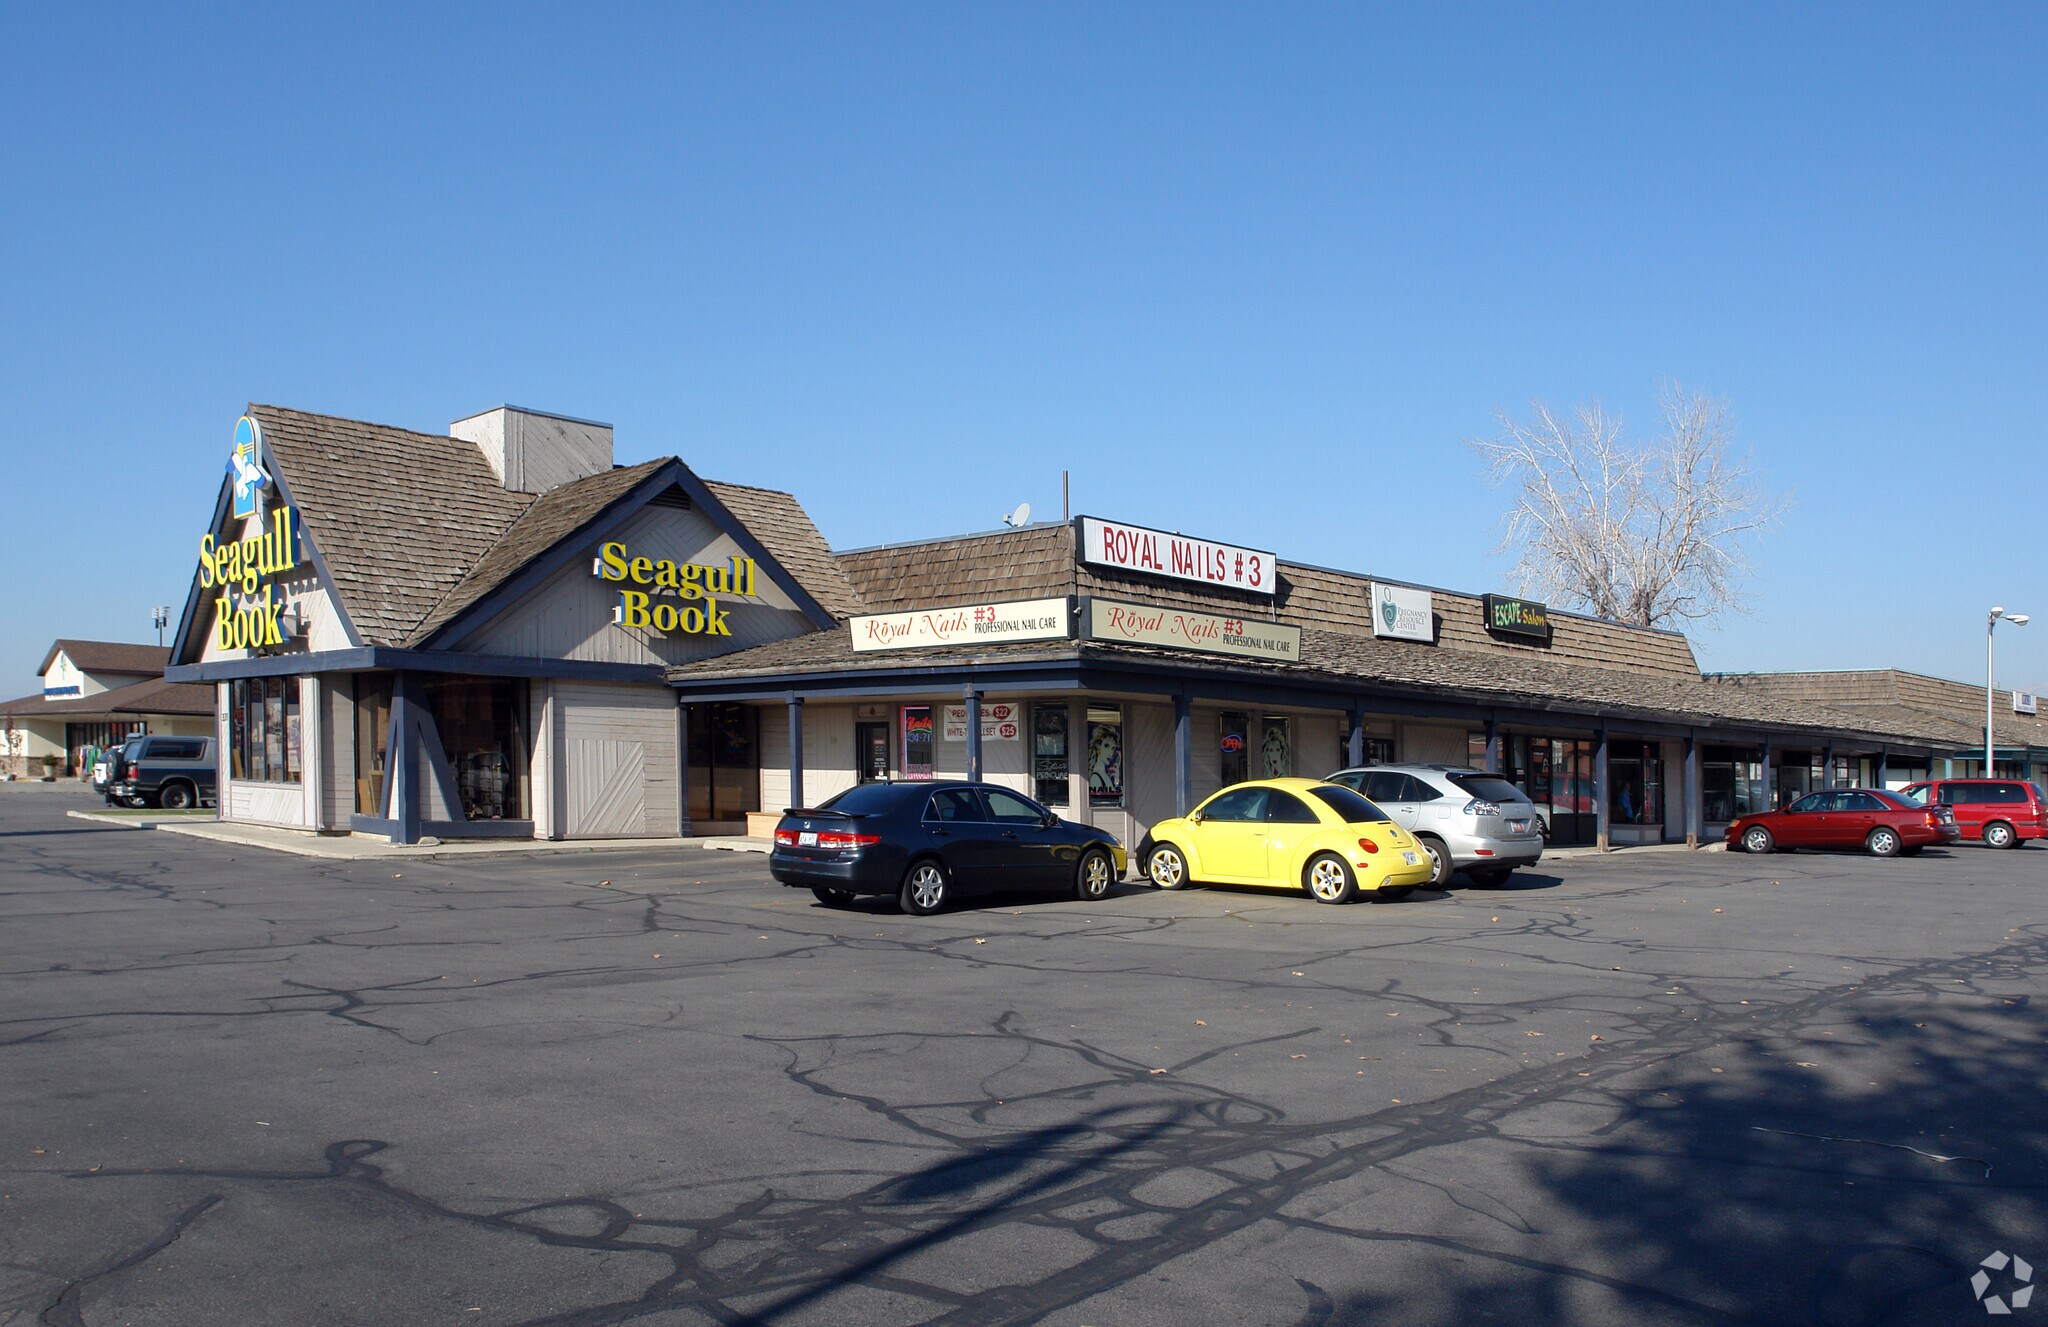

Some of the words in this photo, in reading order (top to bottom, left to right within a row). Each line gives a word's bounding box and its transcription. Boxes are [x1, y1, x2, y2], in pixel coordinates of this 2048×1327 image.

[201, 506, 294, 595] Seagull
[1103, 526, 1163, 570] ROYAL
[1171, 539, 1226, 582] NAILS
[599, 541, 757, 600] Seagull
[216, 584, 283, 650] Book
[619, 589, 732, 636] Book
[1398, 606, 1427, 618] PREGNANCY
[1495, 602, 1521, 626] ESCAPE
[1522, 608, 1545, 627] Salon
[865, 617, 912, 644] Royal
[920, 612, 968, 640] Nails
[974, 606, 996, 622] #3
[974, 619, 1020, 634] PROFESSIONAL
[1022, 618, 1037, 630] NAIL
[1039, 616, 1056, 629] CARE
[1108, 607, 1164, 637] Royal
[1171, 615, 1219, 644] Nails
[1224, 619, 1243, 636] #3
[1396, 619, 1417, 630] CENTER
[1222, 633, 1262, 649] PROFESSIONAL
[1263, 639, 1275, 650] NAIL
[1277, 640, 1290, 652] CARE
[952, 708, 990, 718] PEDES
[995, 707, 1008, 717] $22
[1001, 726, 1015, 737] $25
[1220, 737, 1242, 750] OPEN
[1036, 771, 1068, 780] PEDICURE
[1090, 786, 1122, 794] NAILS
